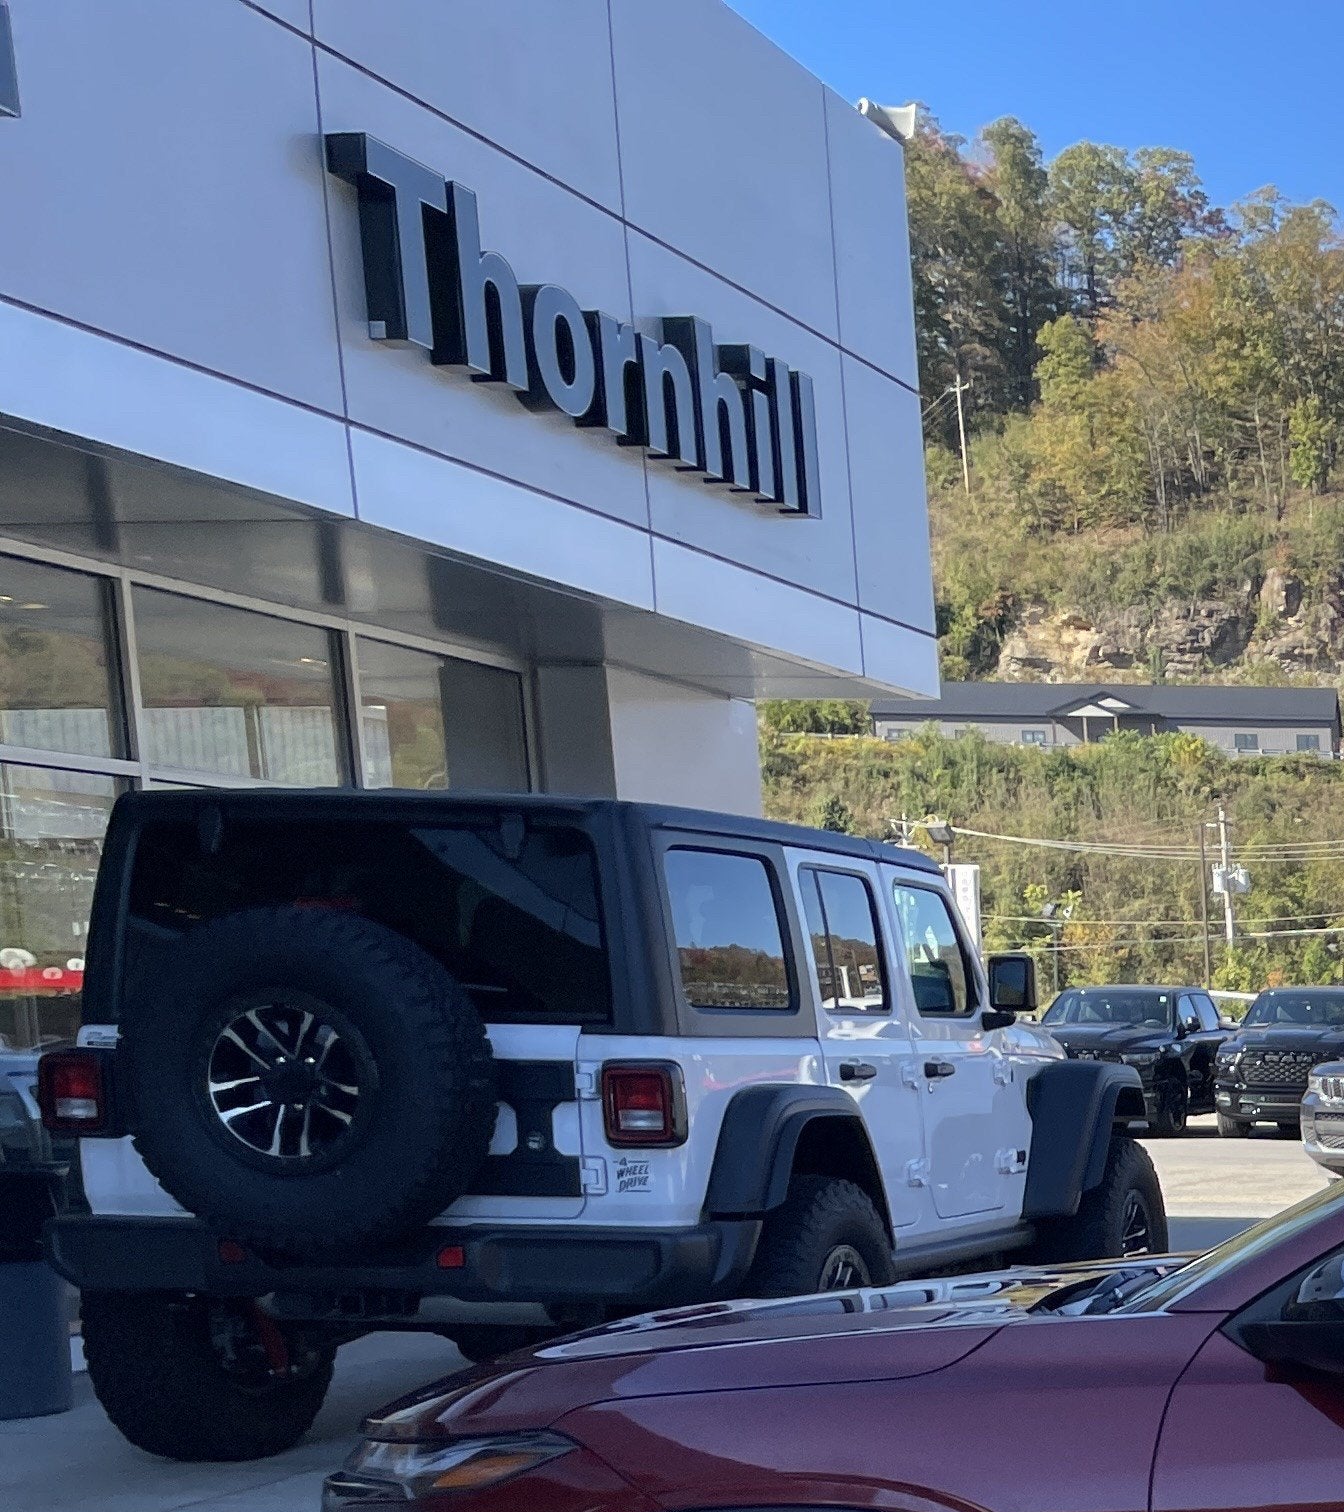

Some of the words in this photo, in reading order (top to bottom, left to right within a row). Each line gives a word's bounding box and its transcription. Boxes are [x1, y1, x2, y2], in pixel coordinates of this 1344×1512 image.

[326, 132, 823, 520] Thornhill
[618, 1156, 628, 1166] 4
[616, 1164, 650, 1180] WHEEL
[618, 1175, 650, 1193] DRIVE
